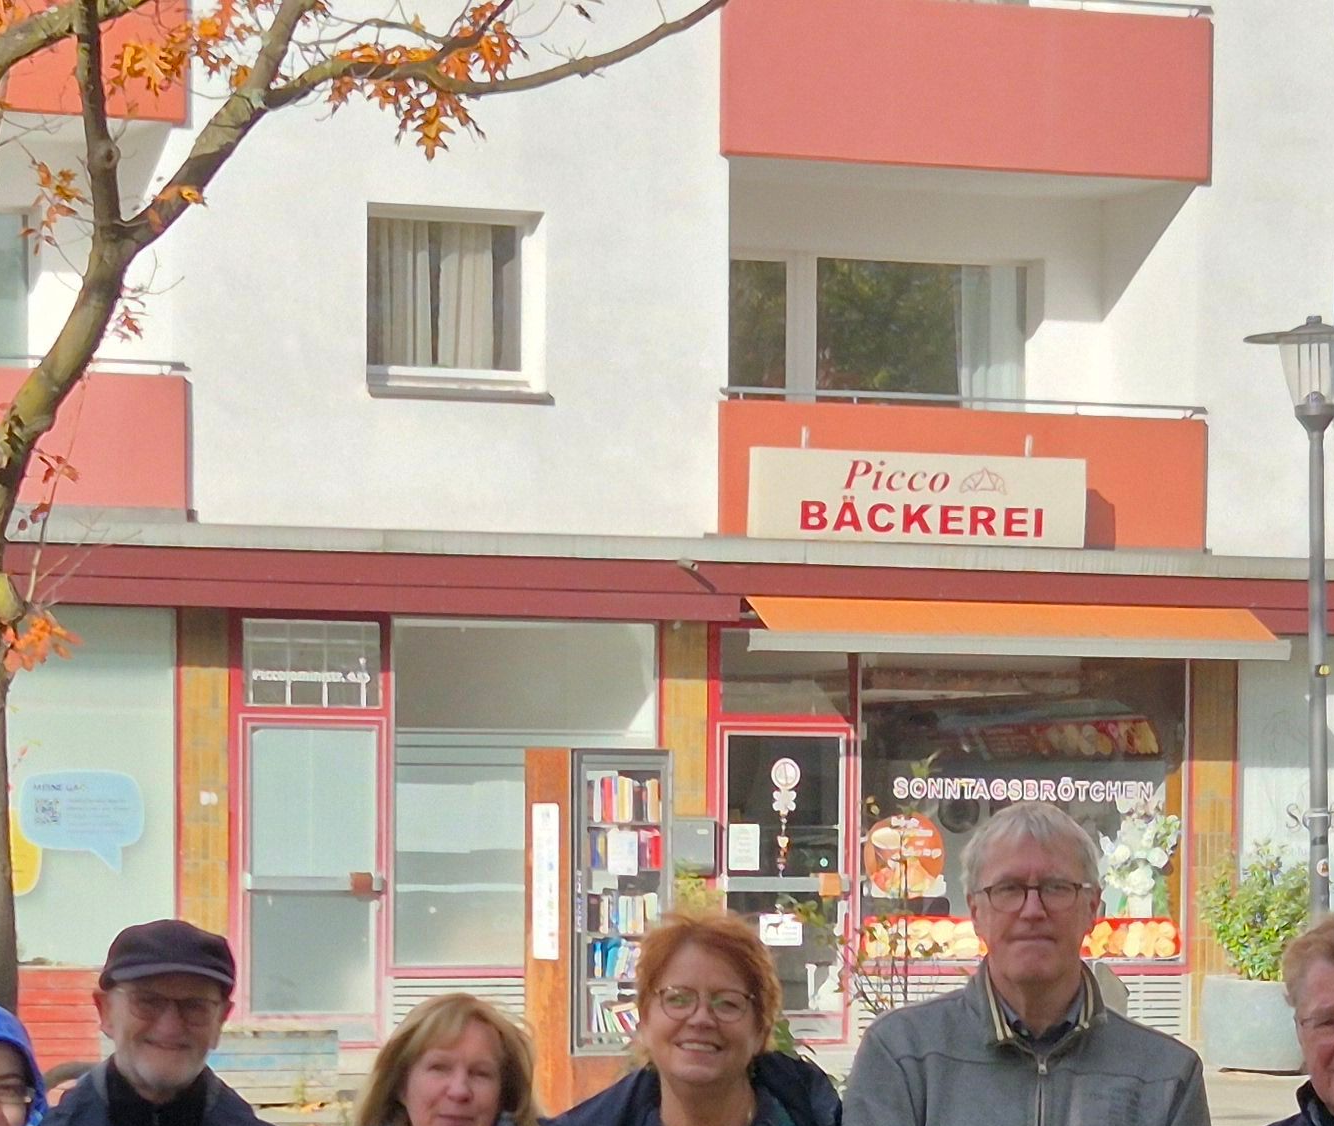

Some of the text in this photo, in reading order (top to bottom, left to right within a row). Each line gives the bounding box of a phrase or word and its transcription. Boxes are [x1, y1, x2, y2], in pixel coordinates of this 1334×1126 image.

[842, 459, 951, 492] Picco
[799, 495, 1043, 538] BÄCKEREI
[893, 777, 1154, 801] SONNTAGSBRÖTCHEN
